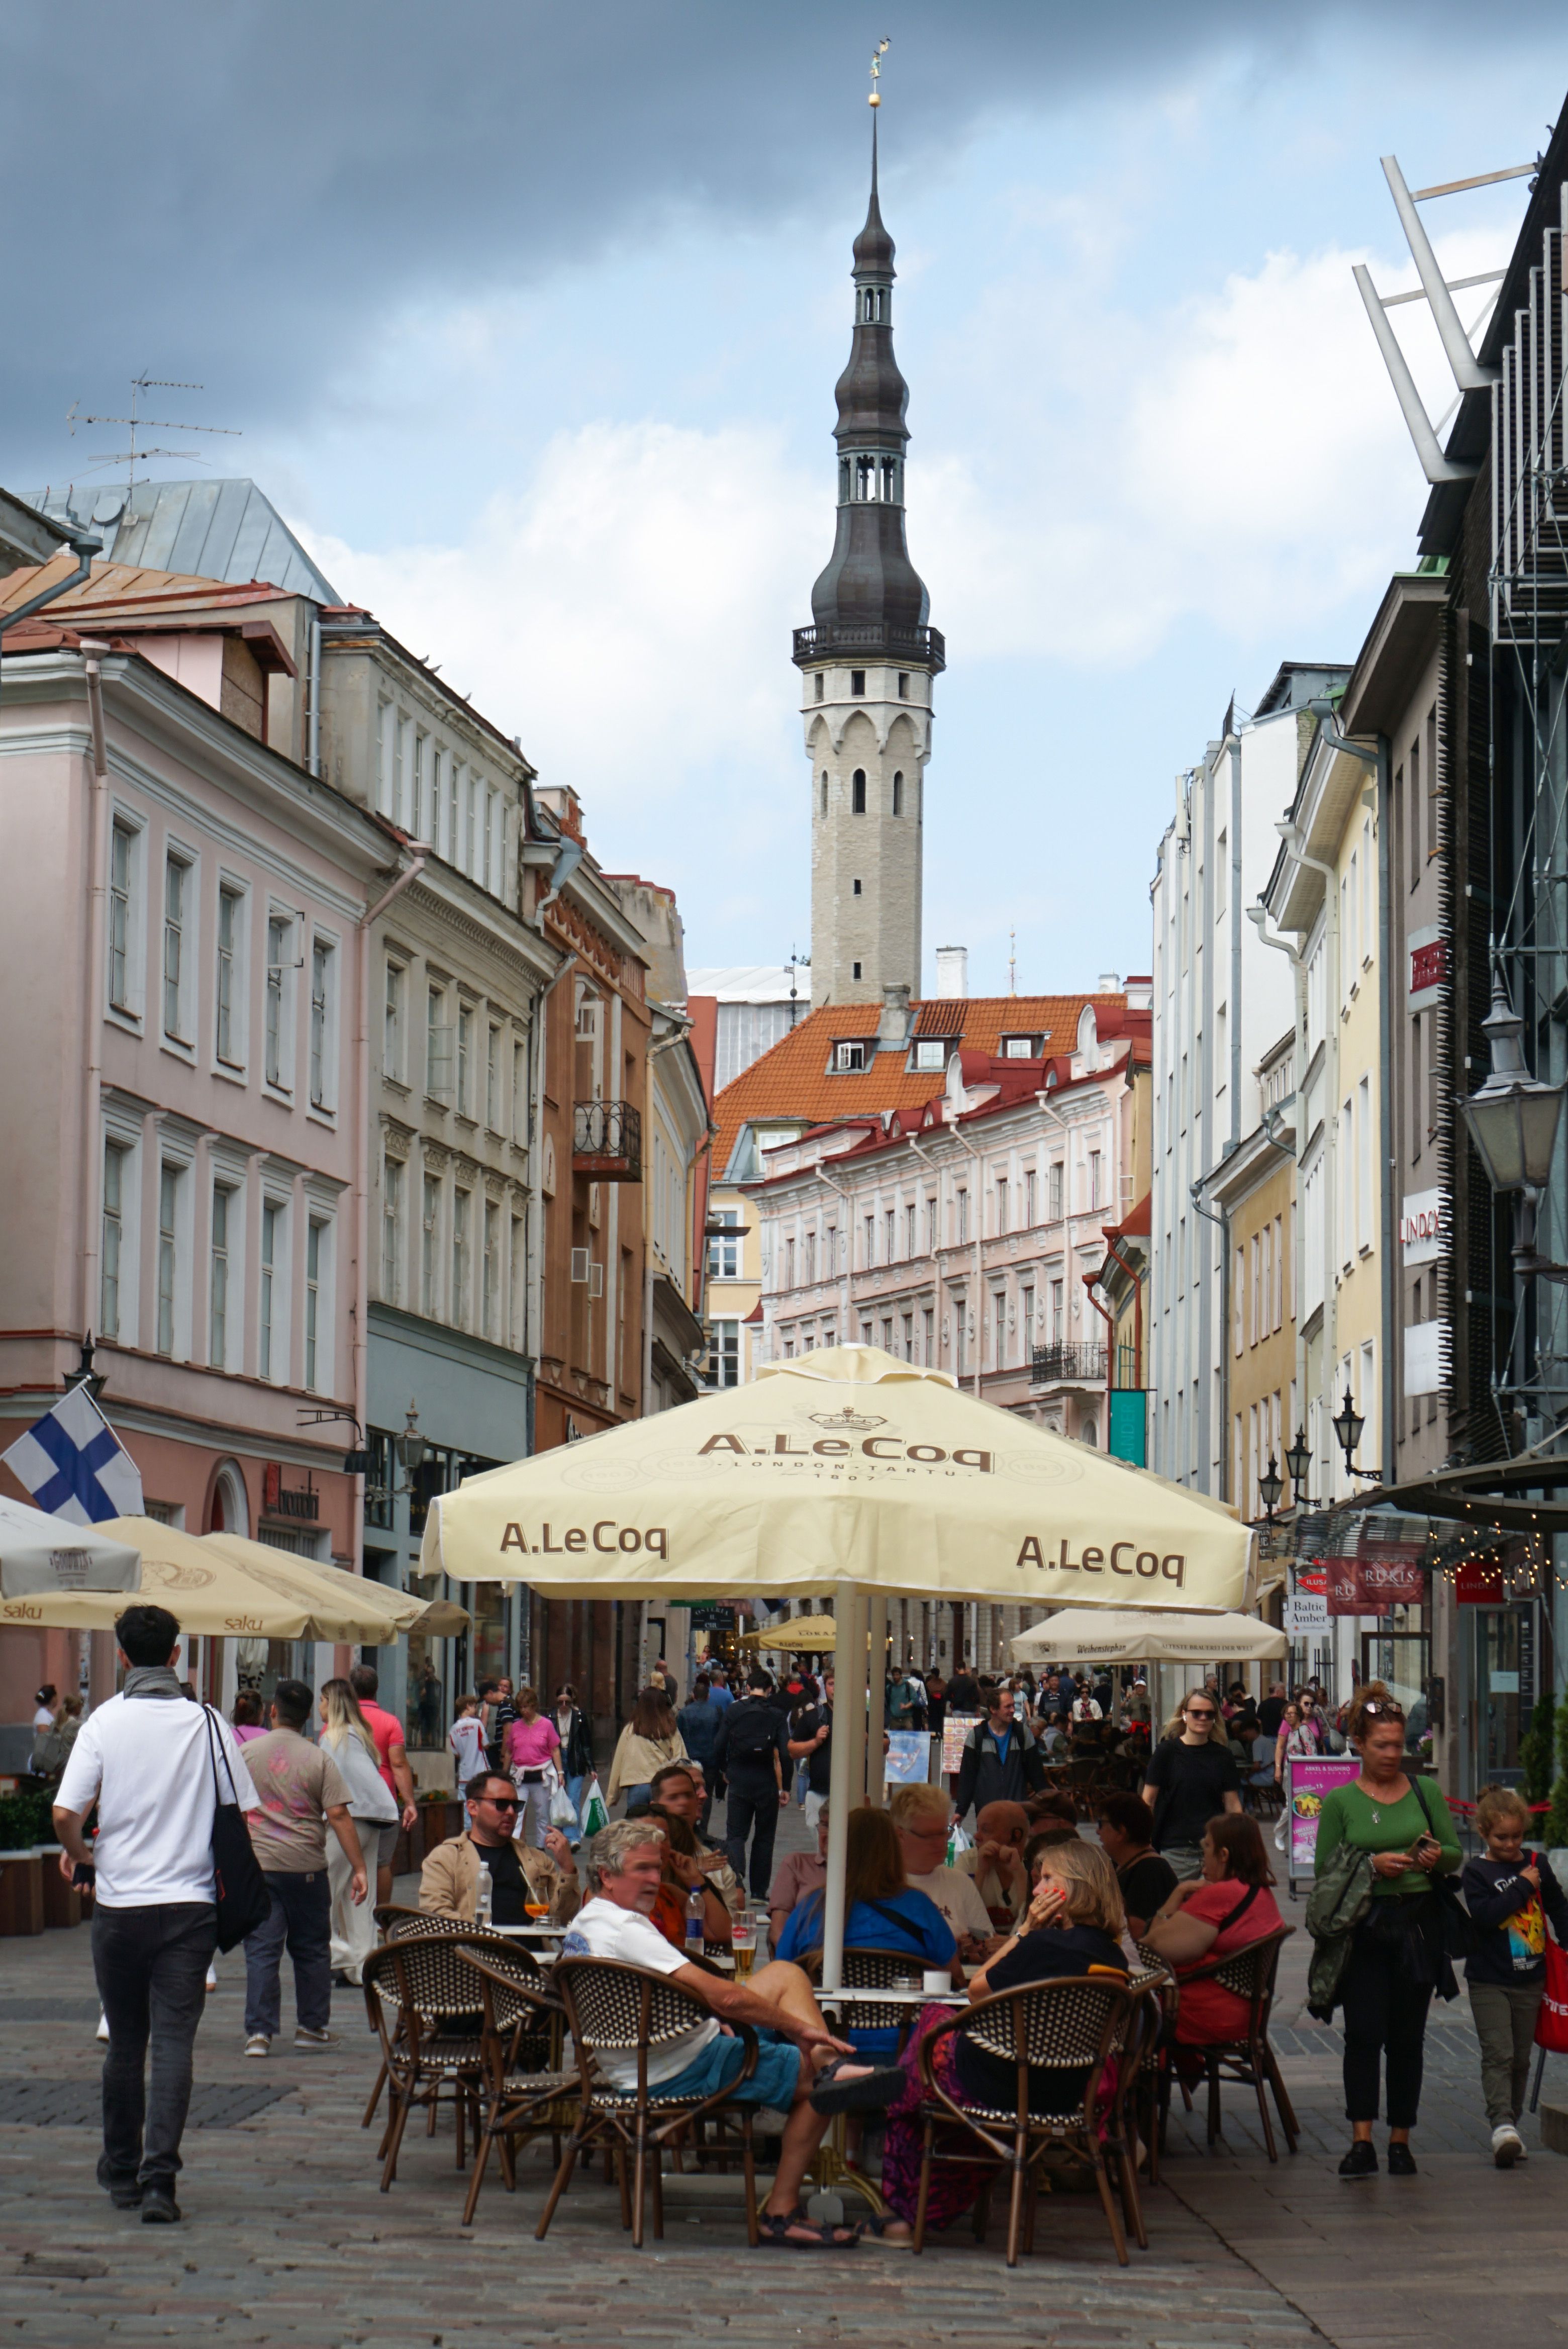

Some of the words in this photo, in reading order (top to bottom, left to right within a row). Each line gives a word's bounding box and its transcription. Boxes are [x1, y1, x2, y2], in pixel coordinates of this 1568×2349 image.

[1399, 1208, 1441, 1244] LINDEX
[1121, 1404, 1135, 1462] ANDER
[697, 1434, 994, 1474] A.LeCoq
[500, 1521, 669, 1562] A.LeCoq
[1016, 1536, 1187, 1590] A.LeCoq
[1365, 1569, 1414, 1583] RUKIS
[3, 1603, 42, 1620] saku
[1294, 1602, 1324, 1611] Baltic
[224, 1615, 263, 1631] saku
[1292, 1614, 1327, 1623] Amber
[1077, 1642, 1126, 1654] Weihenstephan
